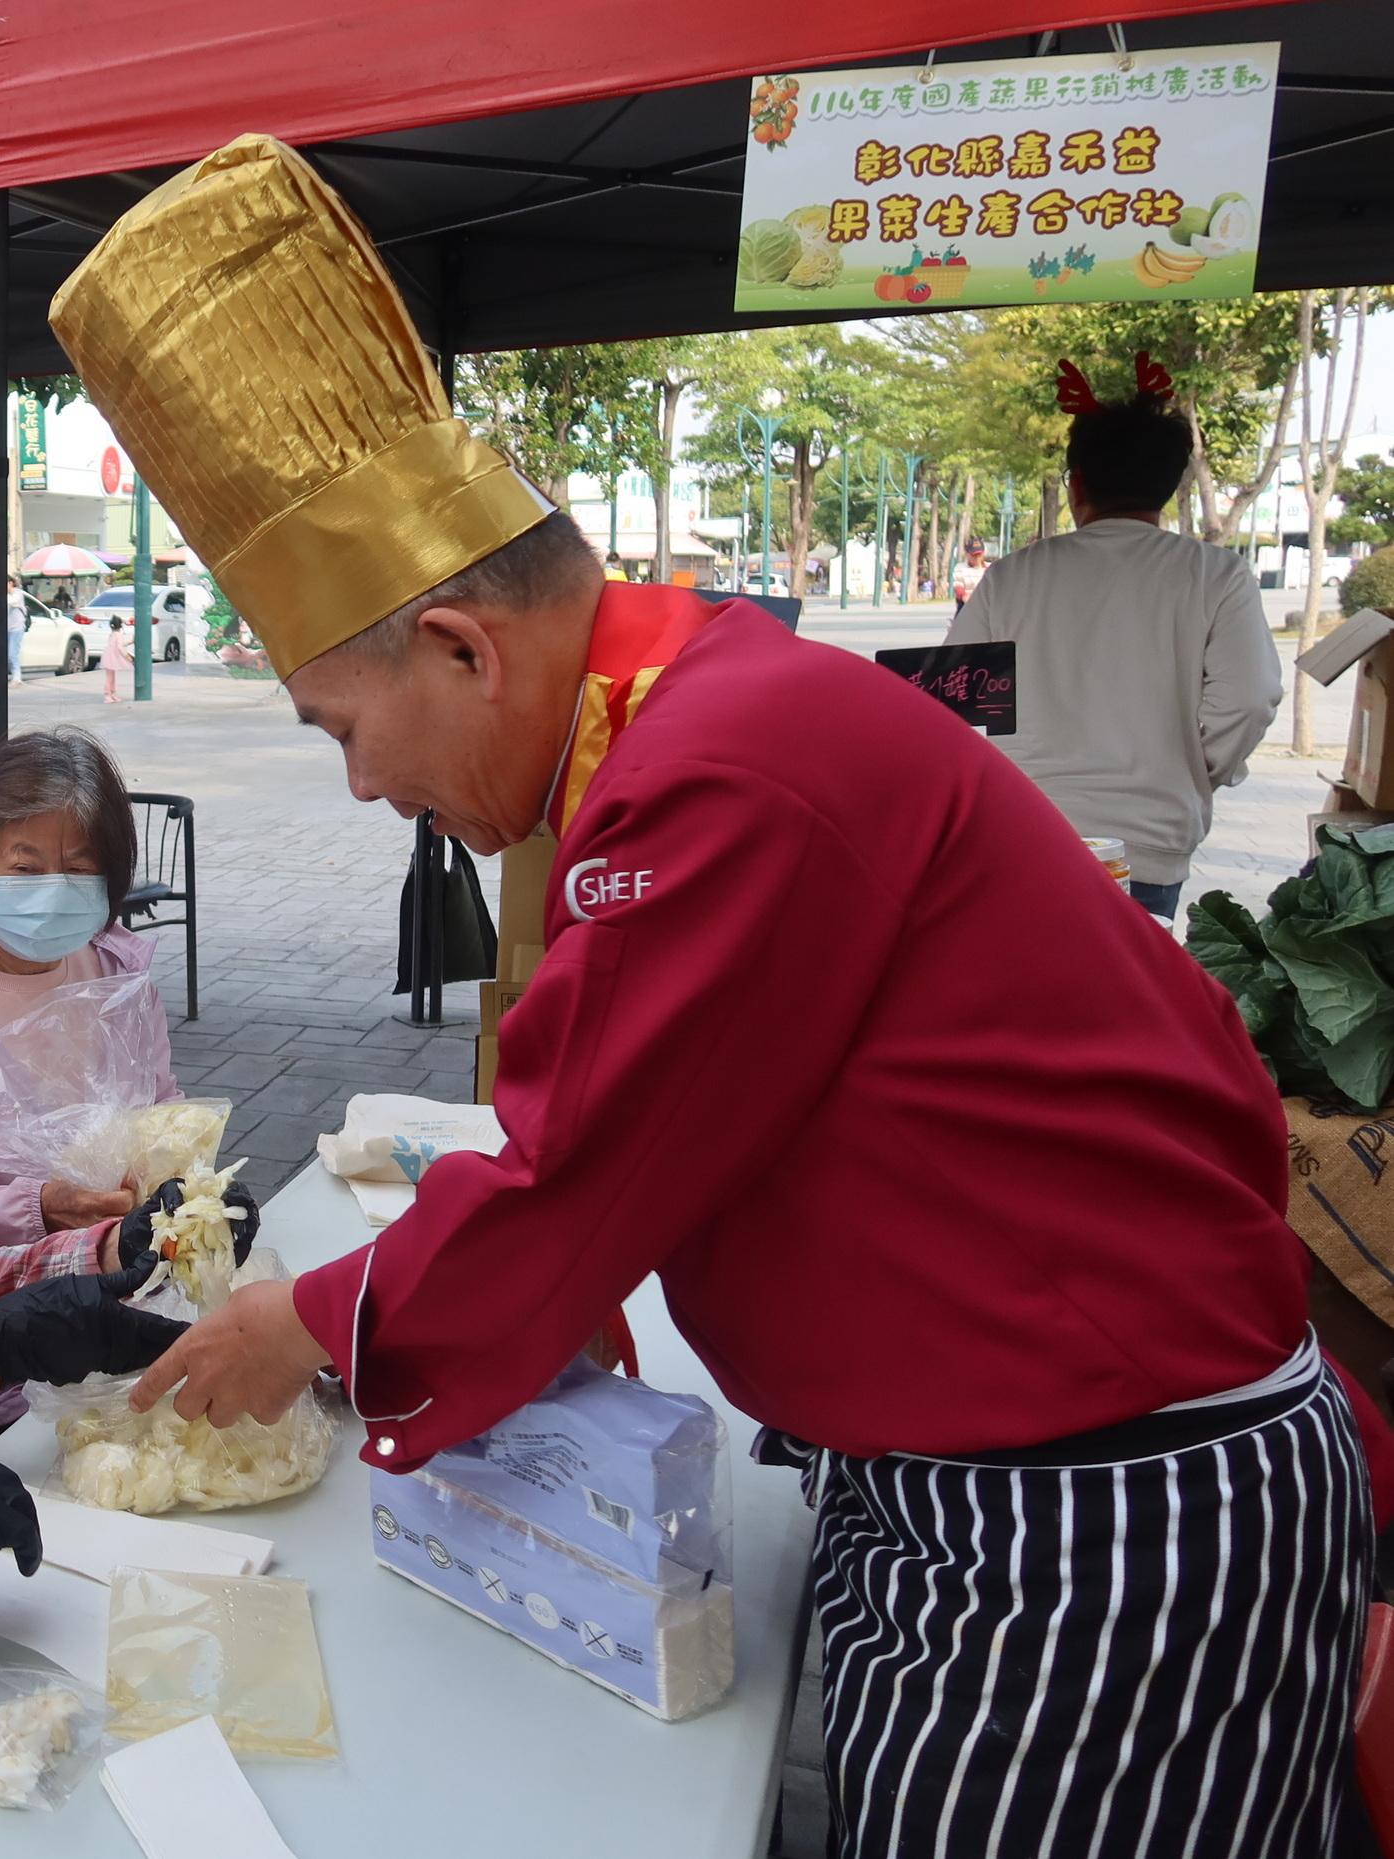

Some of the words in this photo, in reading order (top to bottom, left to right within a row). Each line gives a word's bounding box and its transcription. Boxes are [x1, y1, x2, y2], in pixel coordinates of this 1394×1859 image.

[810, 64, 1270, 114] 114年度國產蔬果行銷推廣活動
[854, 126, 1162, 185] 彰化縣嘉禾益
[826, 187, 1185, 243] 果菜生產合作社
